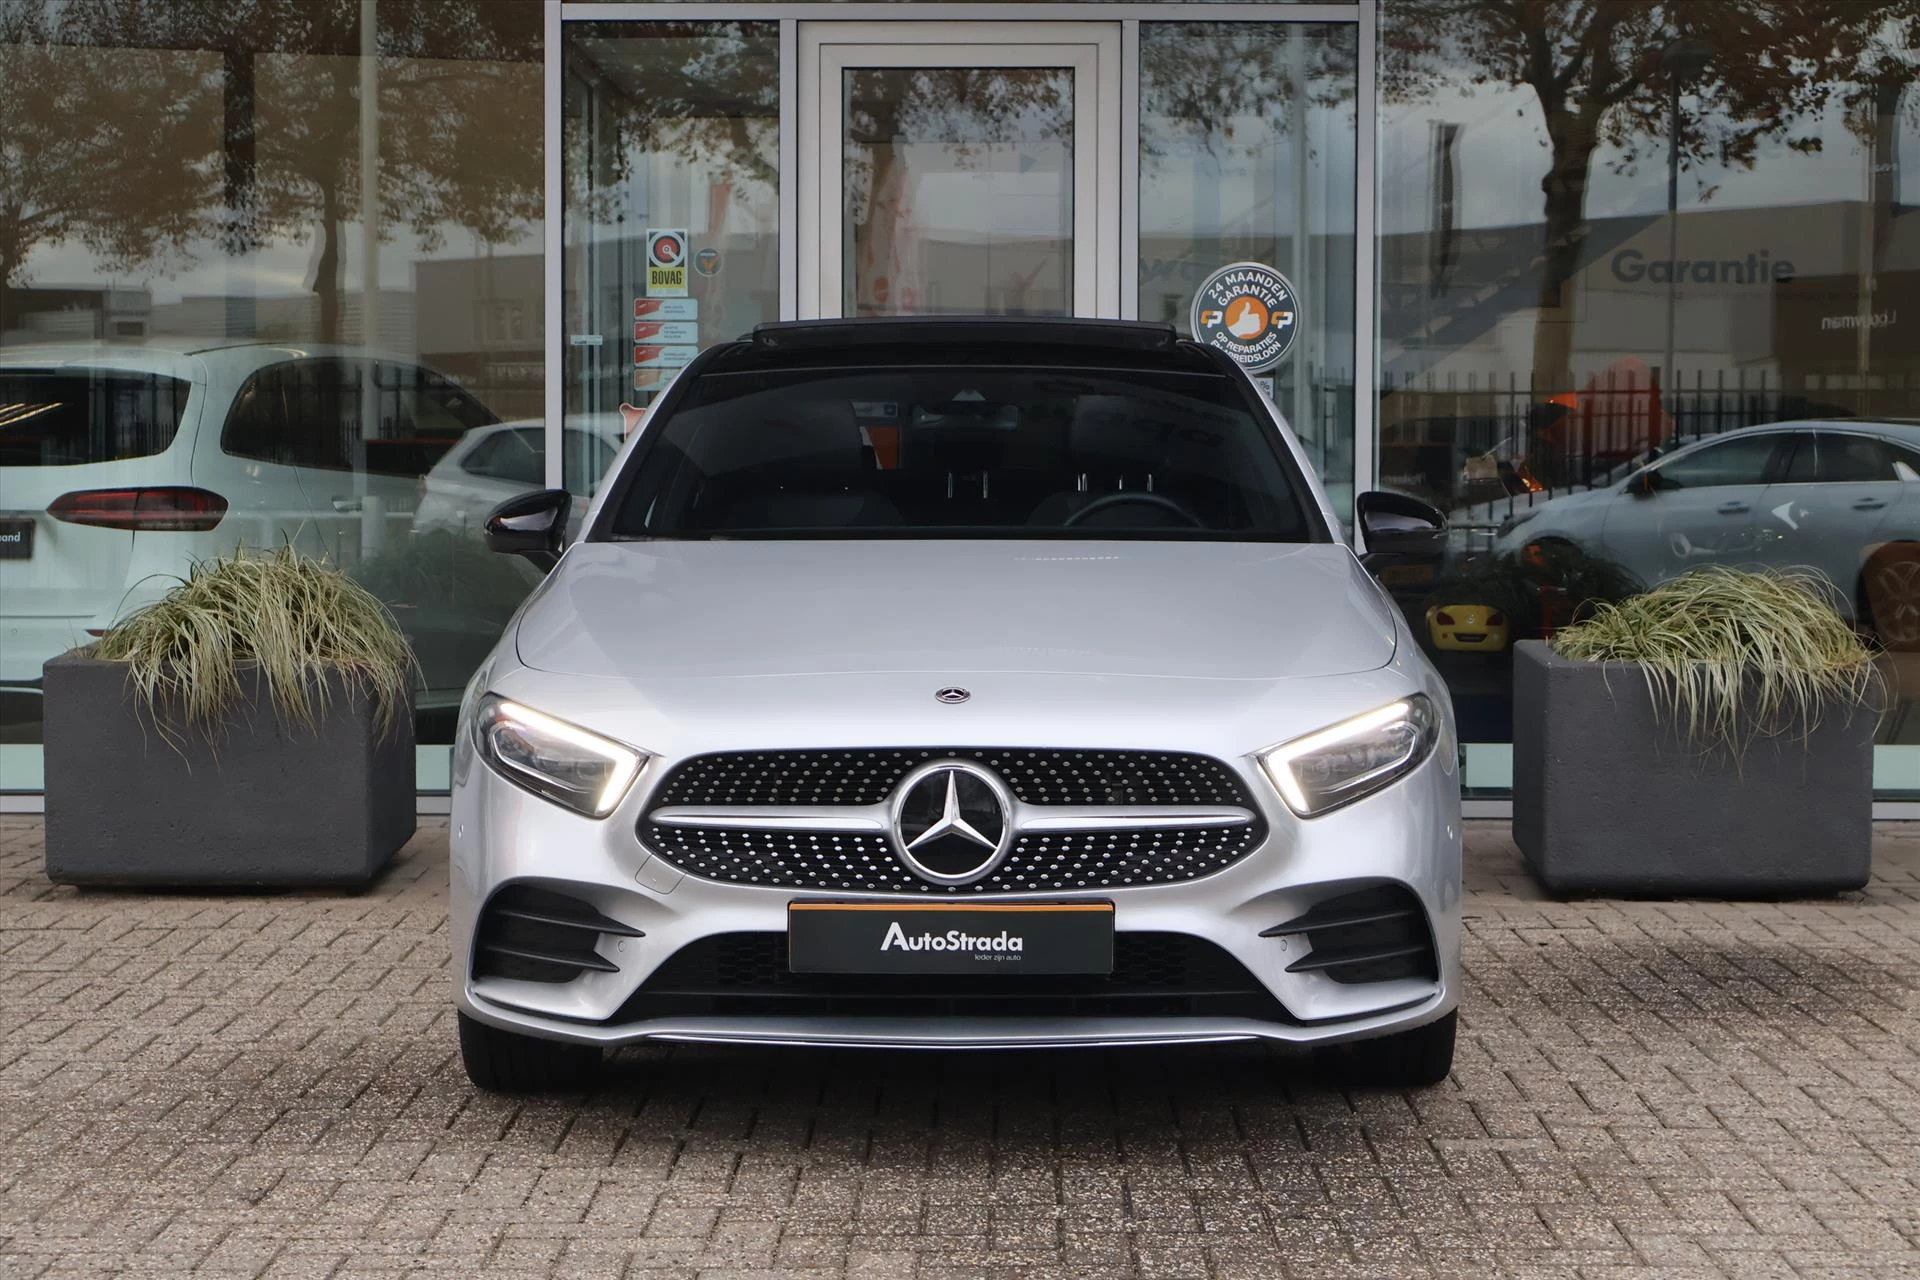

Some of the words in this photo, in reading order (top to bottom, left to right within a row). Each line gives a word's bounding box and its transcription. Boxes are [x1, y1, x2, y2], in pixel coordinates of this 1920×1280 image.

[652, 270, 682, 285] BOVAG
[1611, 249, 1795, 283] Garantie
[1208, 282, 1224, 299] 24
[1225, 271, 1288, 301] MAANDEN
[1217, 284, 1278, 309] GARANTIE
[1216, 331, 1229, 343] OP
[1226, 331, 1277, 354] REPARATIES
[0, 531, 21, 542] and
[880, 921, 1023, 951] AutoStrada
